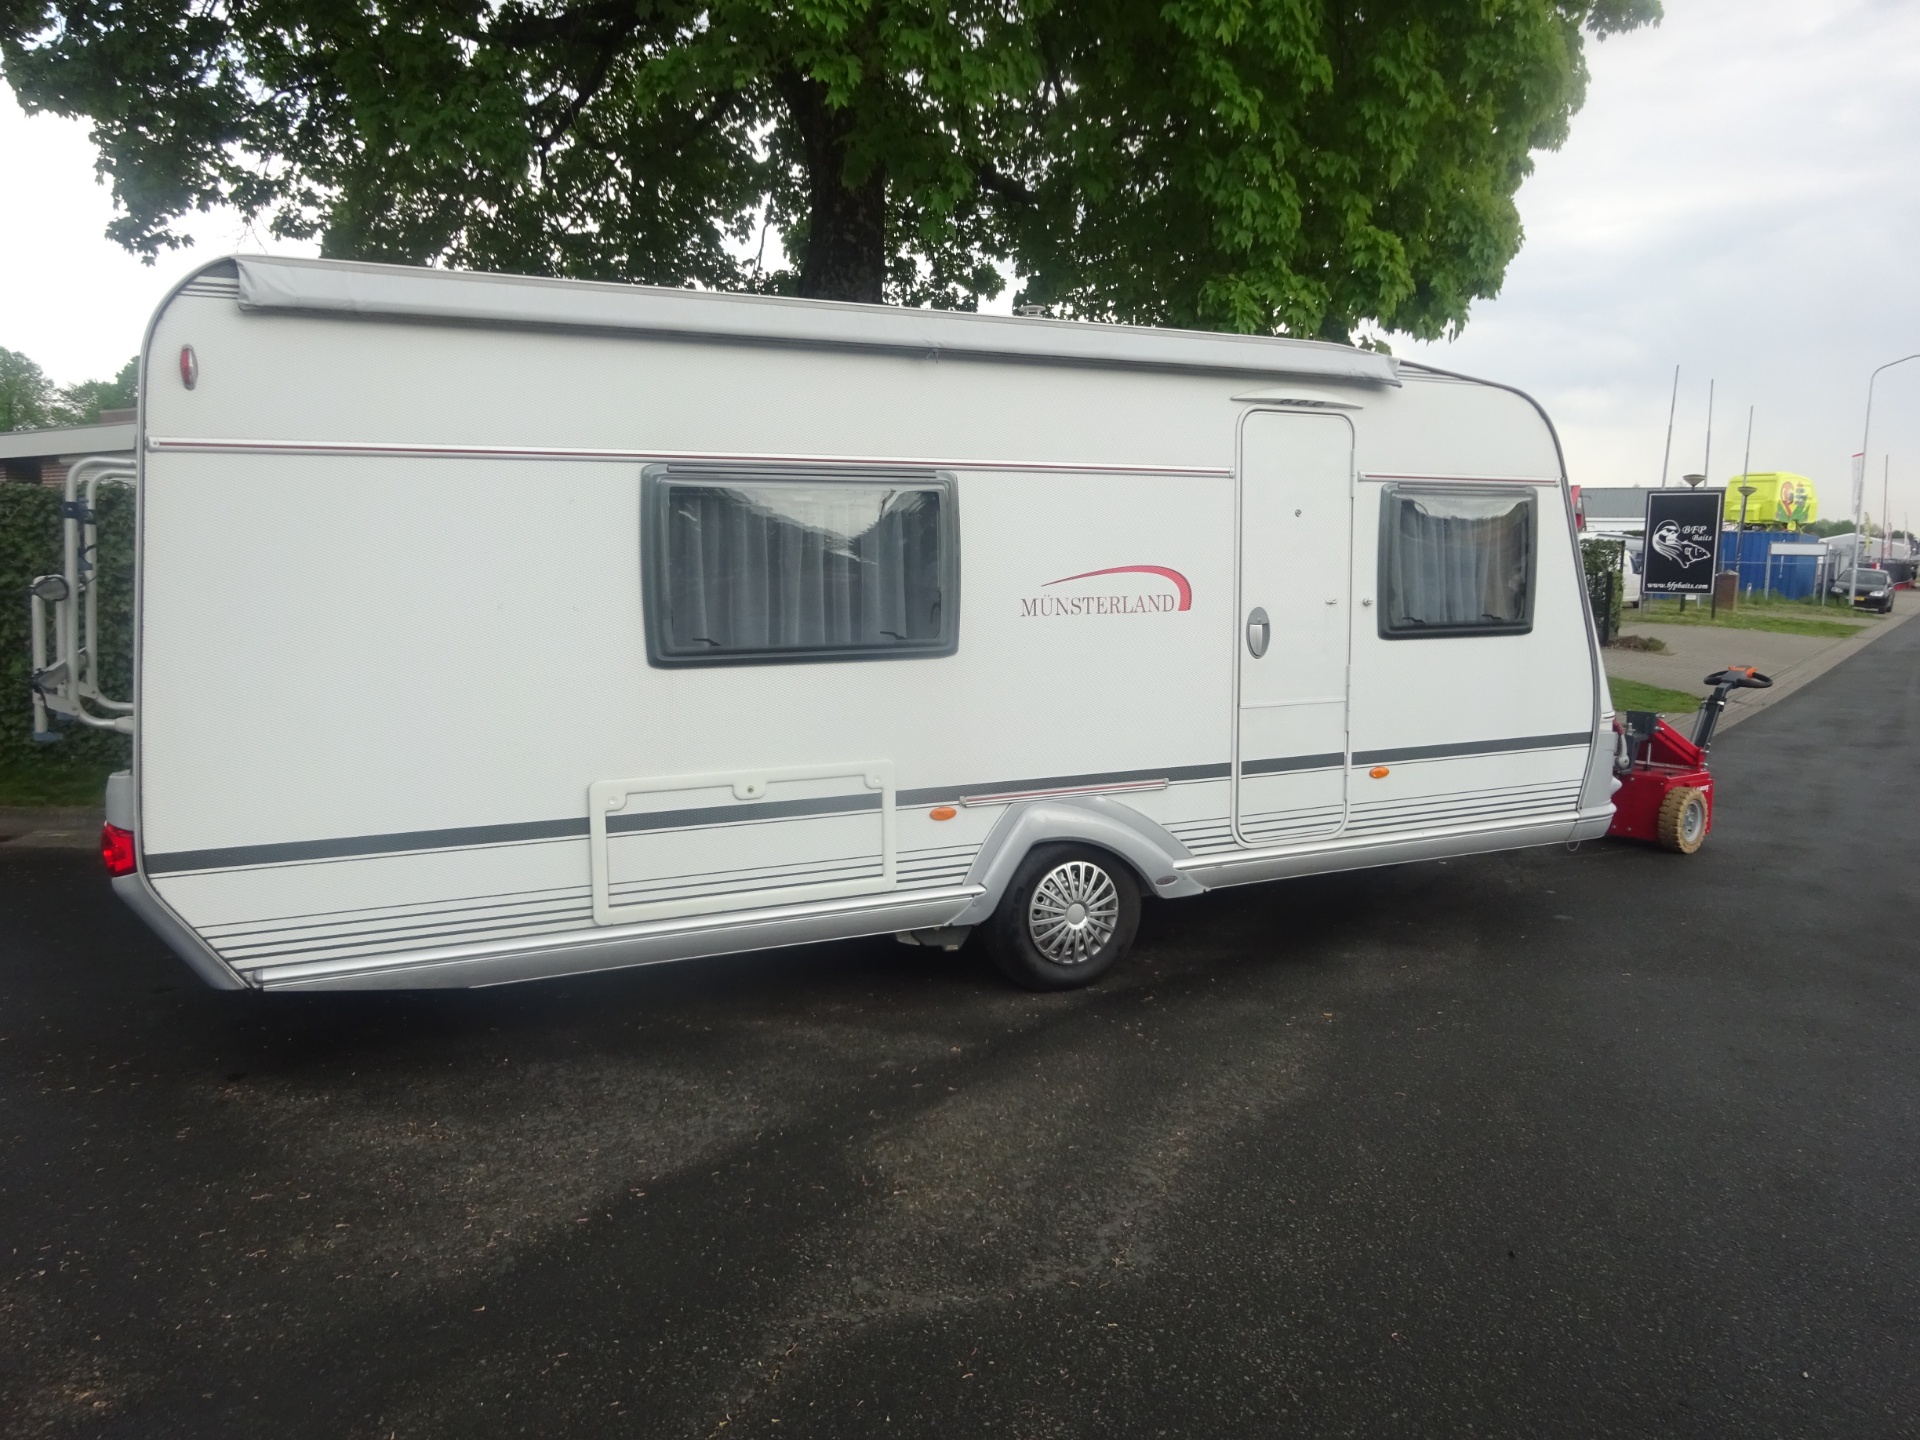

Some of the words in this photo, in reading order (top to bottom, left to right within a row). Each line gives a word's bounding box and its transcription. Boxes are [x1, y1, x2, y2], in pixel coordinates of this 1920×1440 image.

[1682, 525, 1707, 534] BFP
[1647, 581, 1708, 590] www.bfpbaits.com
[1020, 594, 1175, 617] MÜNSTERLAND
